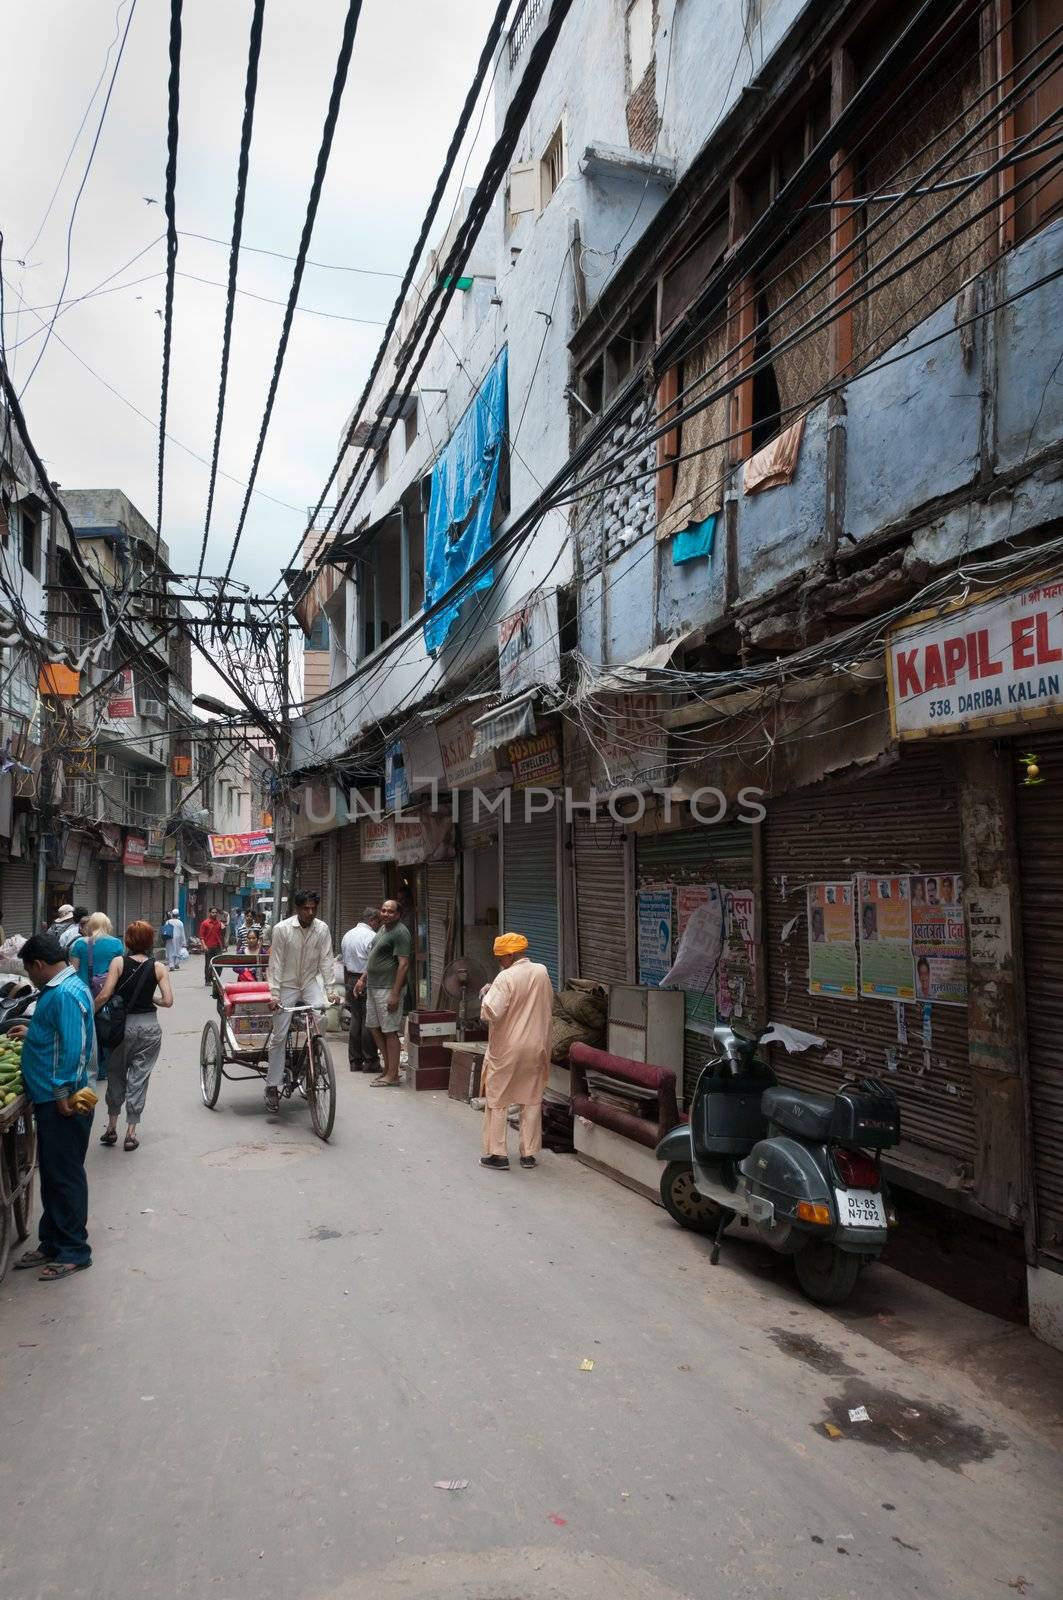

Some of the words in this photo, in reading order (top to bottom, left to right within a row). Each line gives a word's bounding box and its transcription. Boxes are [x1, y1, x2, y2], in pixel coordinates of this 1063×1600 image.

[896, 629, 1003, 698] KAPIL
[1011, 608, 1063, 670] EL
[929, 700, 954, 718] 338,
[958, 687, 1002, 713] DARIBA
[1008, 674, 1060, 703] KALAN
[520, 752, 551, 773] JEWELLERS
